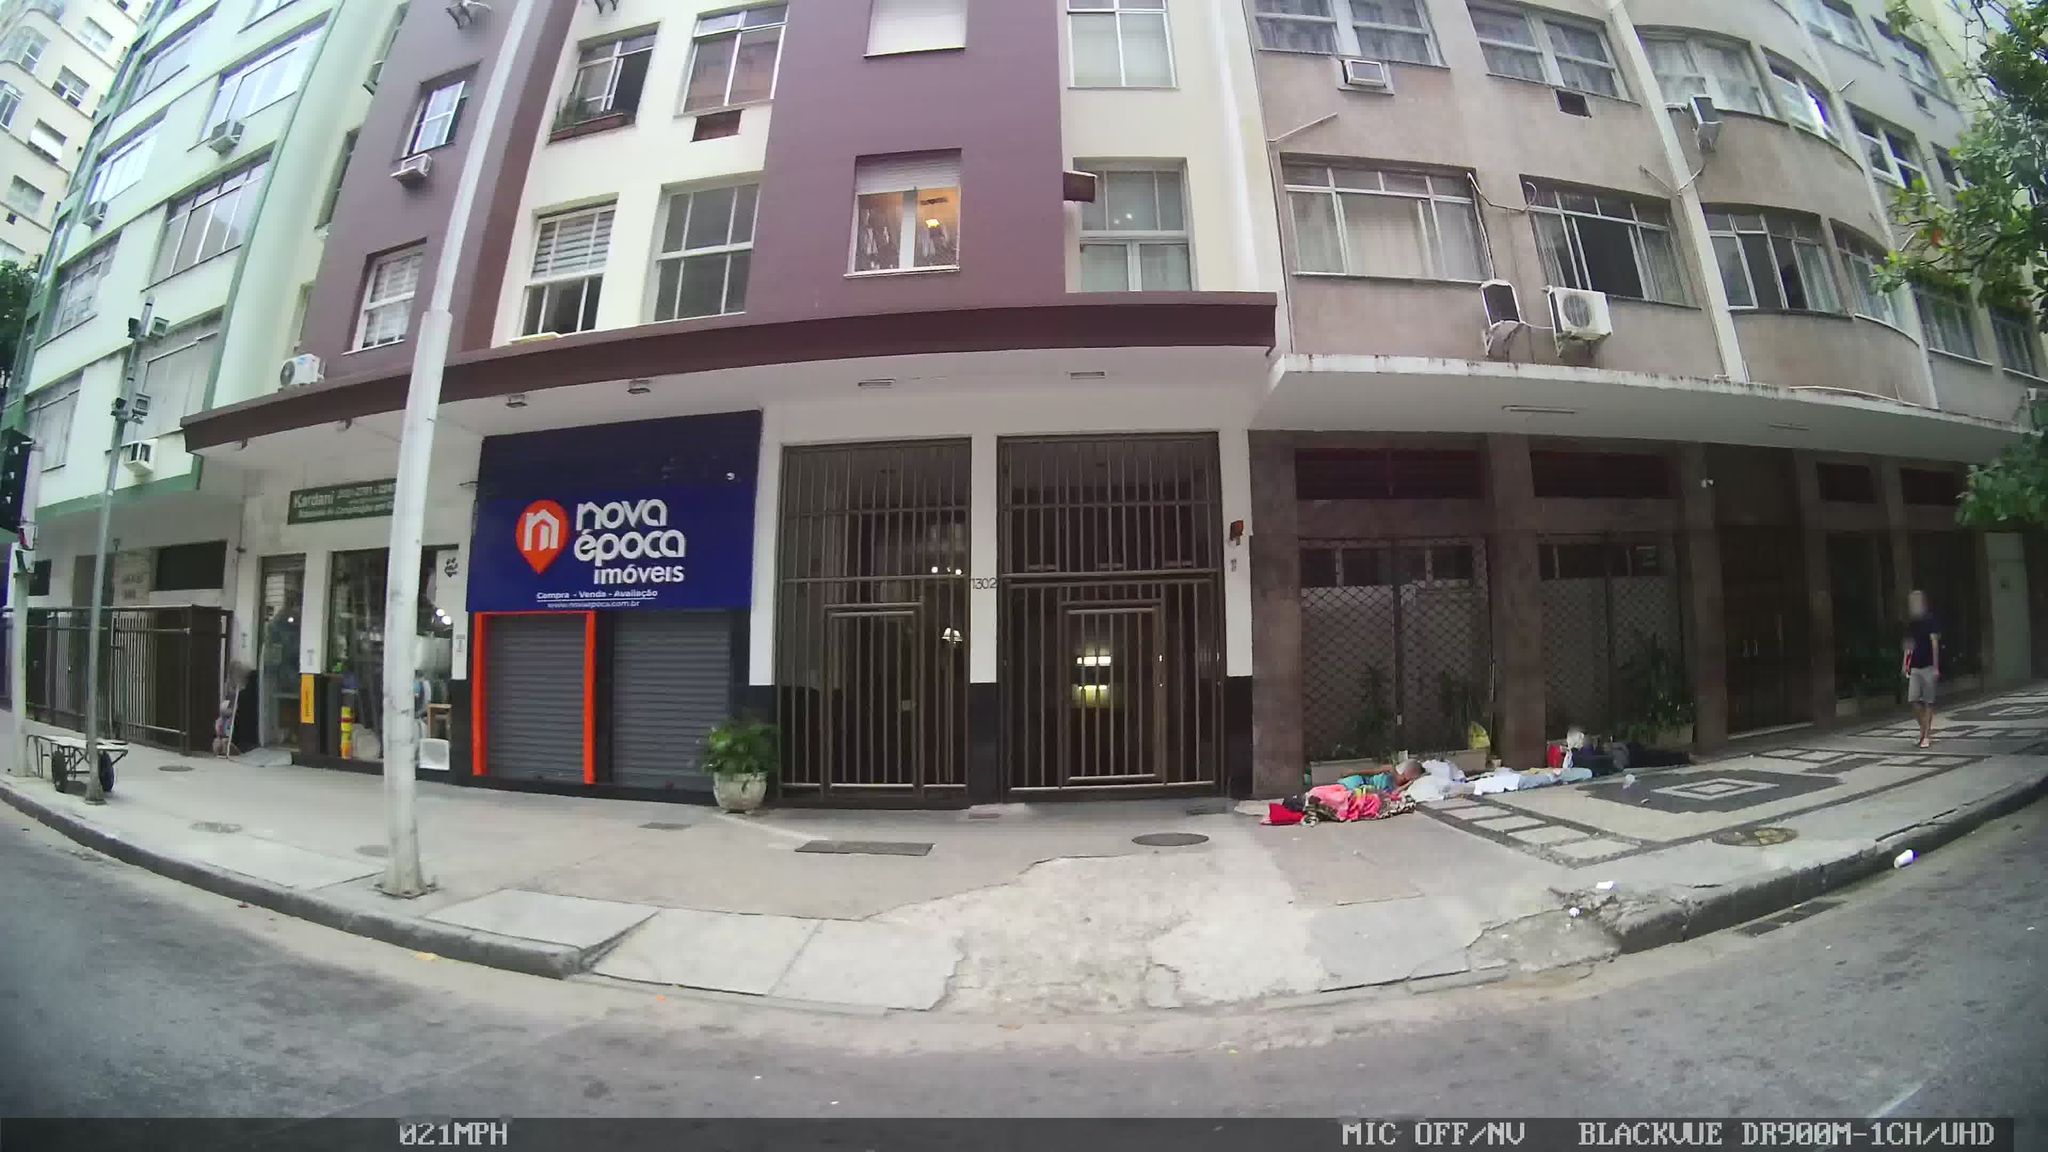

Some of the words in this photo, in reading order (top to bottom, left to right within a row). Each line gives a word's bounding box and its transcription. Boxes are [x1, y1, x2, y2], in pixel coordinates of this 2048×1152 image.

[294, 489, 335, 508] Kardani
[576, 499, 667, 531] nova
[574, 530, 686, 566] época
[594, 565, 684, 584] imóveis
[969, 577, 999, 590] 1302
[536, 591, 570, 600] Compra
[579, 590, 607, 598] Venda
[614, 588, 658, 597] Avaliação
